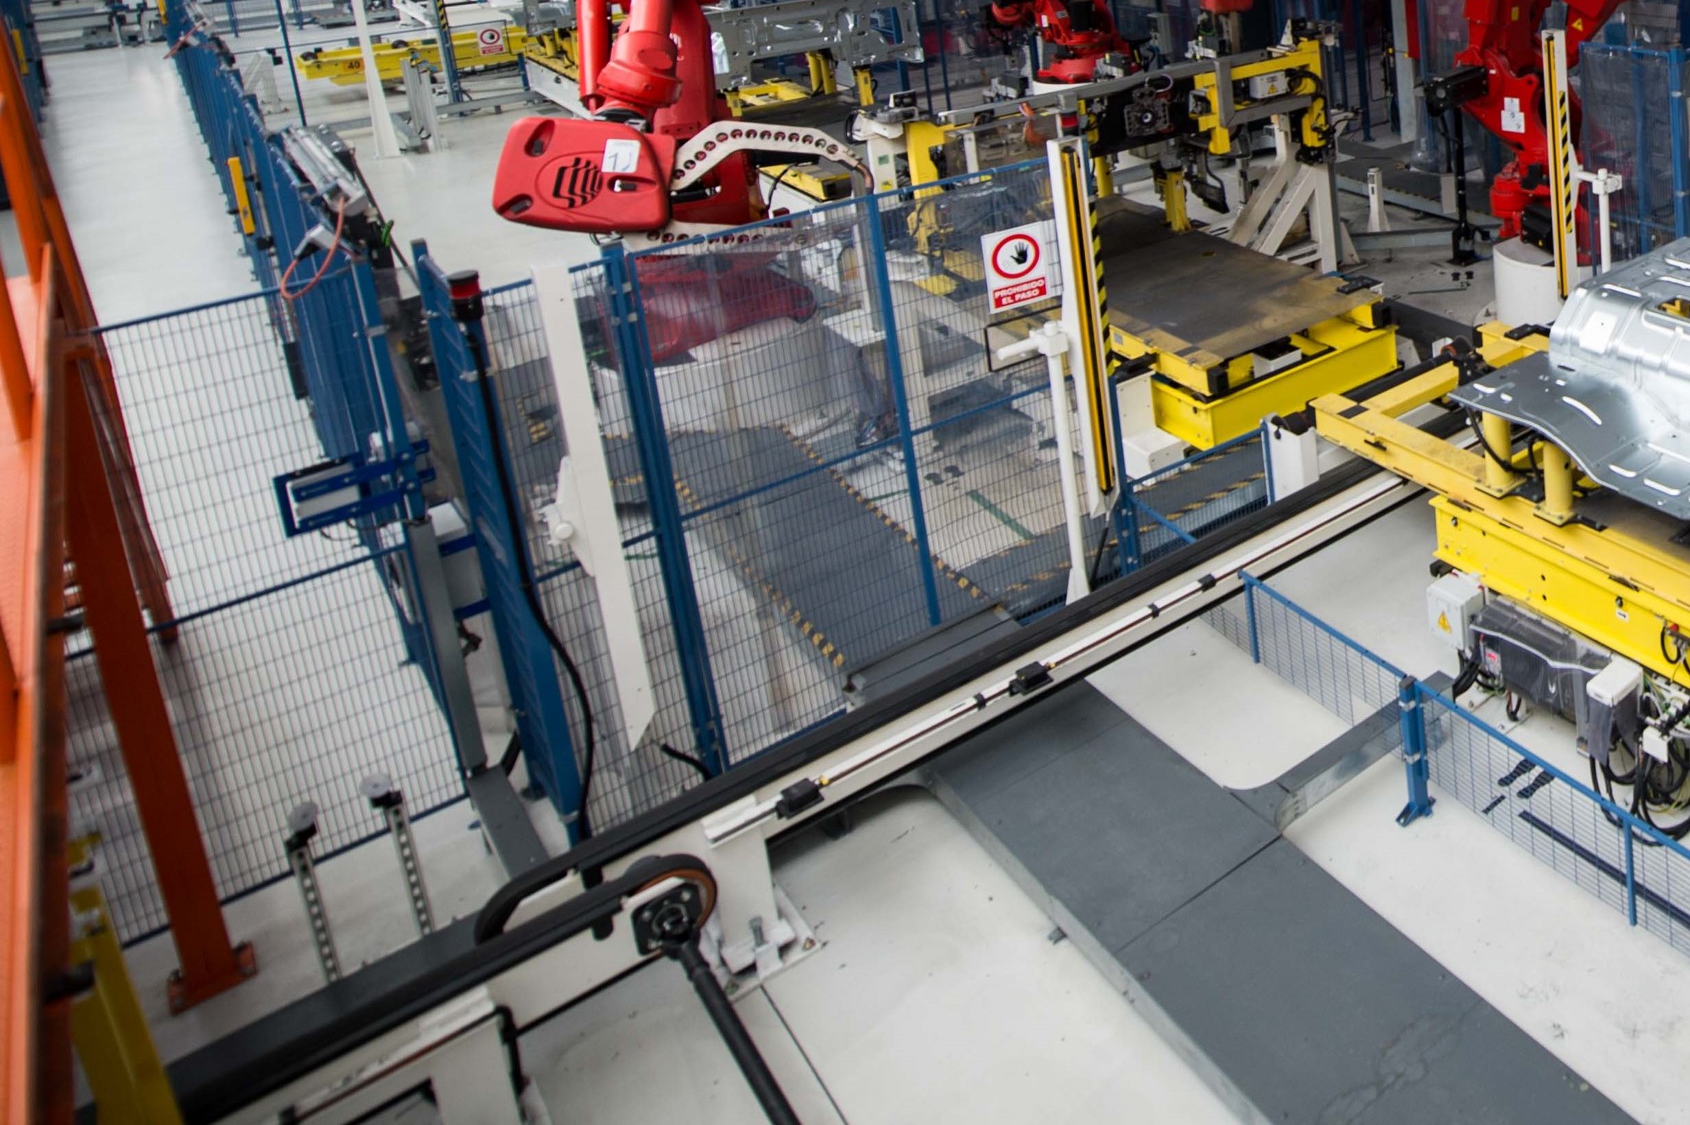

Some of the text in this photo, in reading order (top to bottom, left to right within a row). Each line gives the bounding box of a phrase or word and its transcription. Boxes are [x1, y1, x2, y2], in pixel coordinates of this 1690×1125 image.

[347, 61, 361, 69] 40
[994, 279, 1045, 300] PROHIBIDO
[1001, 288, 1040, 306] EL PASO
